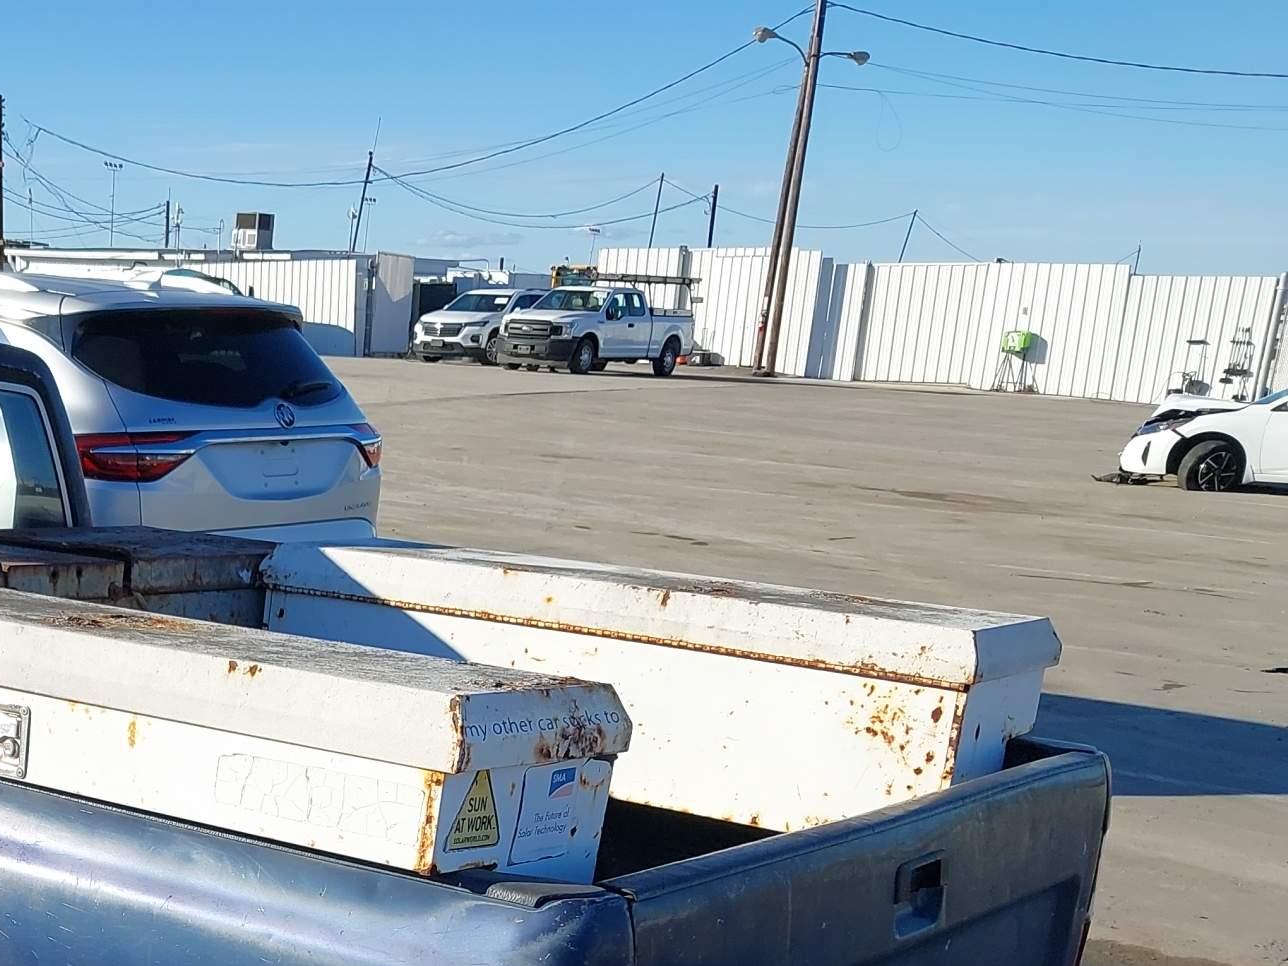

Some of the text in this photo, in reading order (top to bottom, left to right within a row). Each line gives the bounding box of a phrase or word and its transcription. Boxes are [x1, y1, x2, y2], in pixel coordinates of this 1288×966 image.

[464, 724, 488, 741] my
[493, 717, 534, 735] other
[538, 717, 559, 732] car
[604, 710, 620, 724] to
[467, 796, 488, 813] SUN
[454, 815, 496, 834] AT WORK.
[535, 822, 567, 835] Technology
